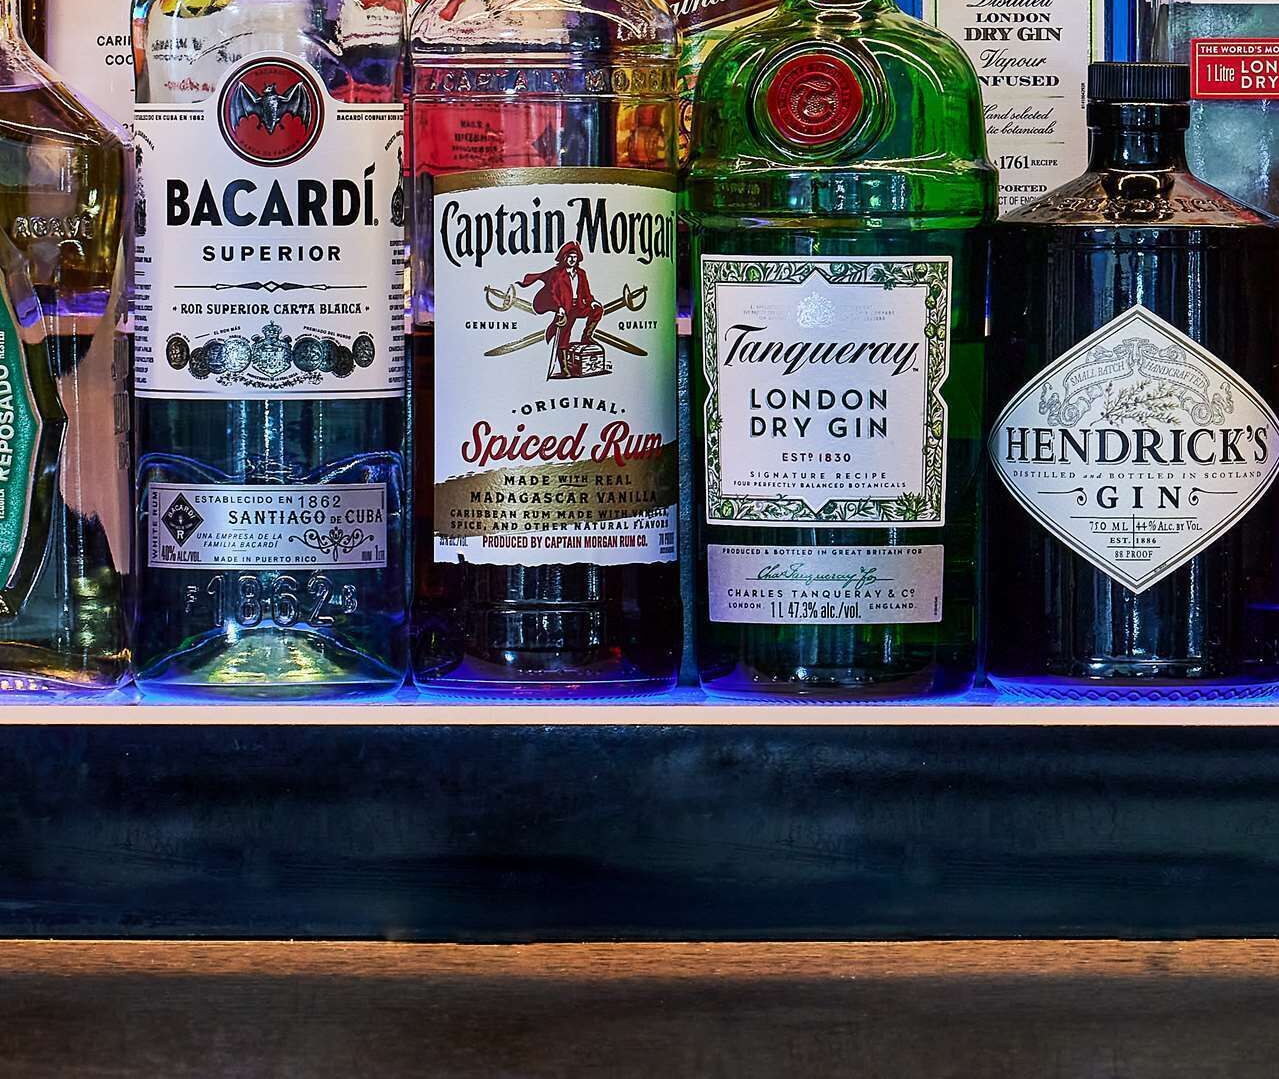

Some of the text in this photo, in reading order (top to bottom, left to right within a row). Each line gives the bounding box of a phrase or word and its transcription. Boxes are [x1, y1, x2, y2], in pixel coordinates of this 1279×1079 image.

[976, 13, 1050, 22] LONDON
[964, 27, 1062, 41] DRY GIN
[980, 49, 1046, 72] Vapour
[167, 162, 375, 227] BACARDÍ
[440, 197, 673, 267] Captain Morgan
[203, 246, 341, 261] SUPERIOR
[181, 303, 362, 315] RON SUPERIOR CARTA BLANCA
[618, 321, 657, 330] QUALITY
[724, 324, 920, 376] Tanqueray
[521, 398, 617, 415] ORIGINAL
[750, 388, 888, 410] LONDON
[750, 417, 888, 438] DRY GIN
[462, 421, 663, 467] Spiced Rum
[1006, 425, 1268, 464] HENDRICK'S
[750, 471, 886, 480] SIGNATURE RECIPE
[1014, 471, 1076, 479] DISTILLED
[471, 491, 657, 504] MADAGASCAR VANILLA
[1097, 486, 1181, 508] GIN
[229, 511, 325, 524] SANTIAGO
[345, 509, 383, 524] CUBA
